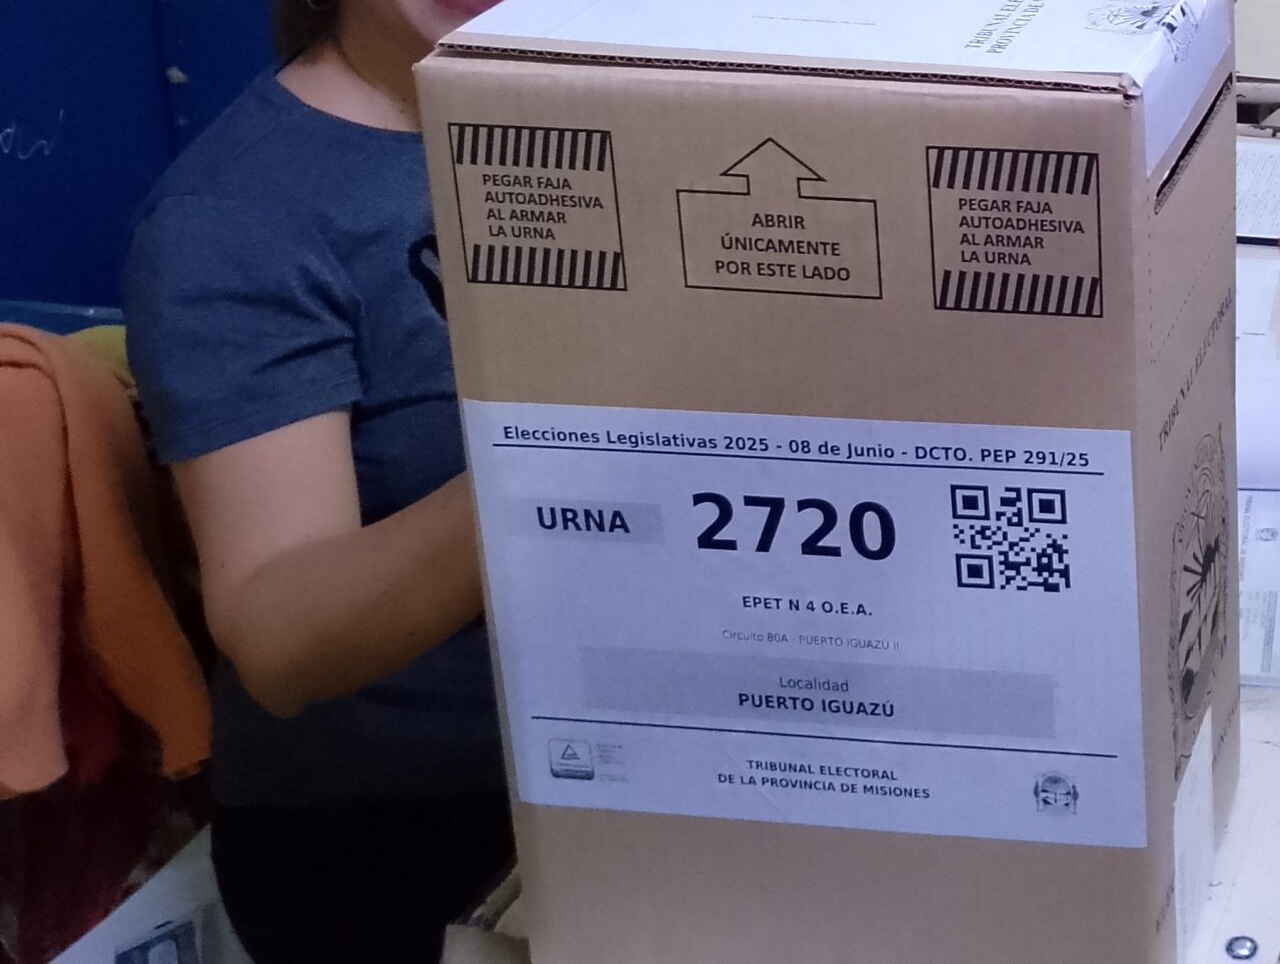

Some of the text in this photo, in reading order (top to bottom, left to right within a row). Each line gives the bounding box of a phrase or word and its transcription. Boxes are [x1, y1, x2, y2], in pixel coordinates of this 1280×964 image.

[986, 13, 1036, 54] PROVINCIA
[482, 173, 572, 190] PEGAR FAJA
[484, 191, 604, 209] AUTOADHESIVA
[958, 198, 1053, 215] PEGAR FAJA
[487, 208, 568, 224] AL ARMAR
[751, 213, 806, 230] ABRIR
[959, 216, 1085, 234] AUTOADHESIVA
[488, 225, 556, 241] LA URNA
[960, 233, 1044, 249] AL ARMAR
[720, 232, 841, 257] ÚNICAMENTE
[960, 250, 1032, 266] LA URNA
[715, 260, 851, 282] POR ESTE LADO
[502, 426, 600, 444] Elecciones
[606, 430, 718, 450] Legislativas
[723, 435, 770, 452] 2025
[788, 439, 811, 454] 08
[818, 440, 840, 456] de
[846, 443, 895, 459] Junio
[915, 445, 974, 462] DCTO.
[980, 449, 1017, 464] PEP
[1023, 450, 1090, 467] 291/25
[536, 491, 897, 561] URNA 2720
[742, 595, 873, 616] EPET N 4 O.E.A.
[722, 629, 764, 642] Circuito
[800, 635, 844, 647] PUERTO
[779, 676, 850, 693] Localidad
[738, 693, 895, 718] PUERTO IGUAZÚ
[746, 759, 898, 781] TRIBUNAL ELECTORAL
[718, 773, 931, 799] DE LA PROVINCIA DE MISIONES
